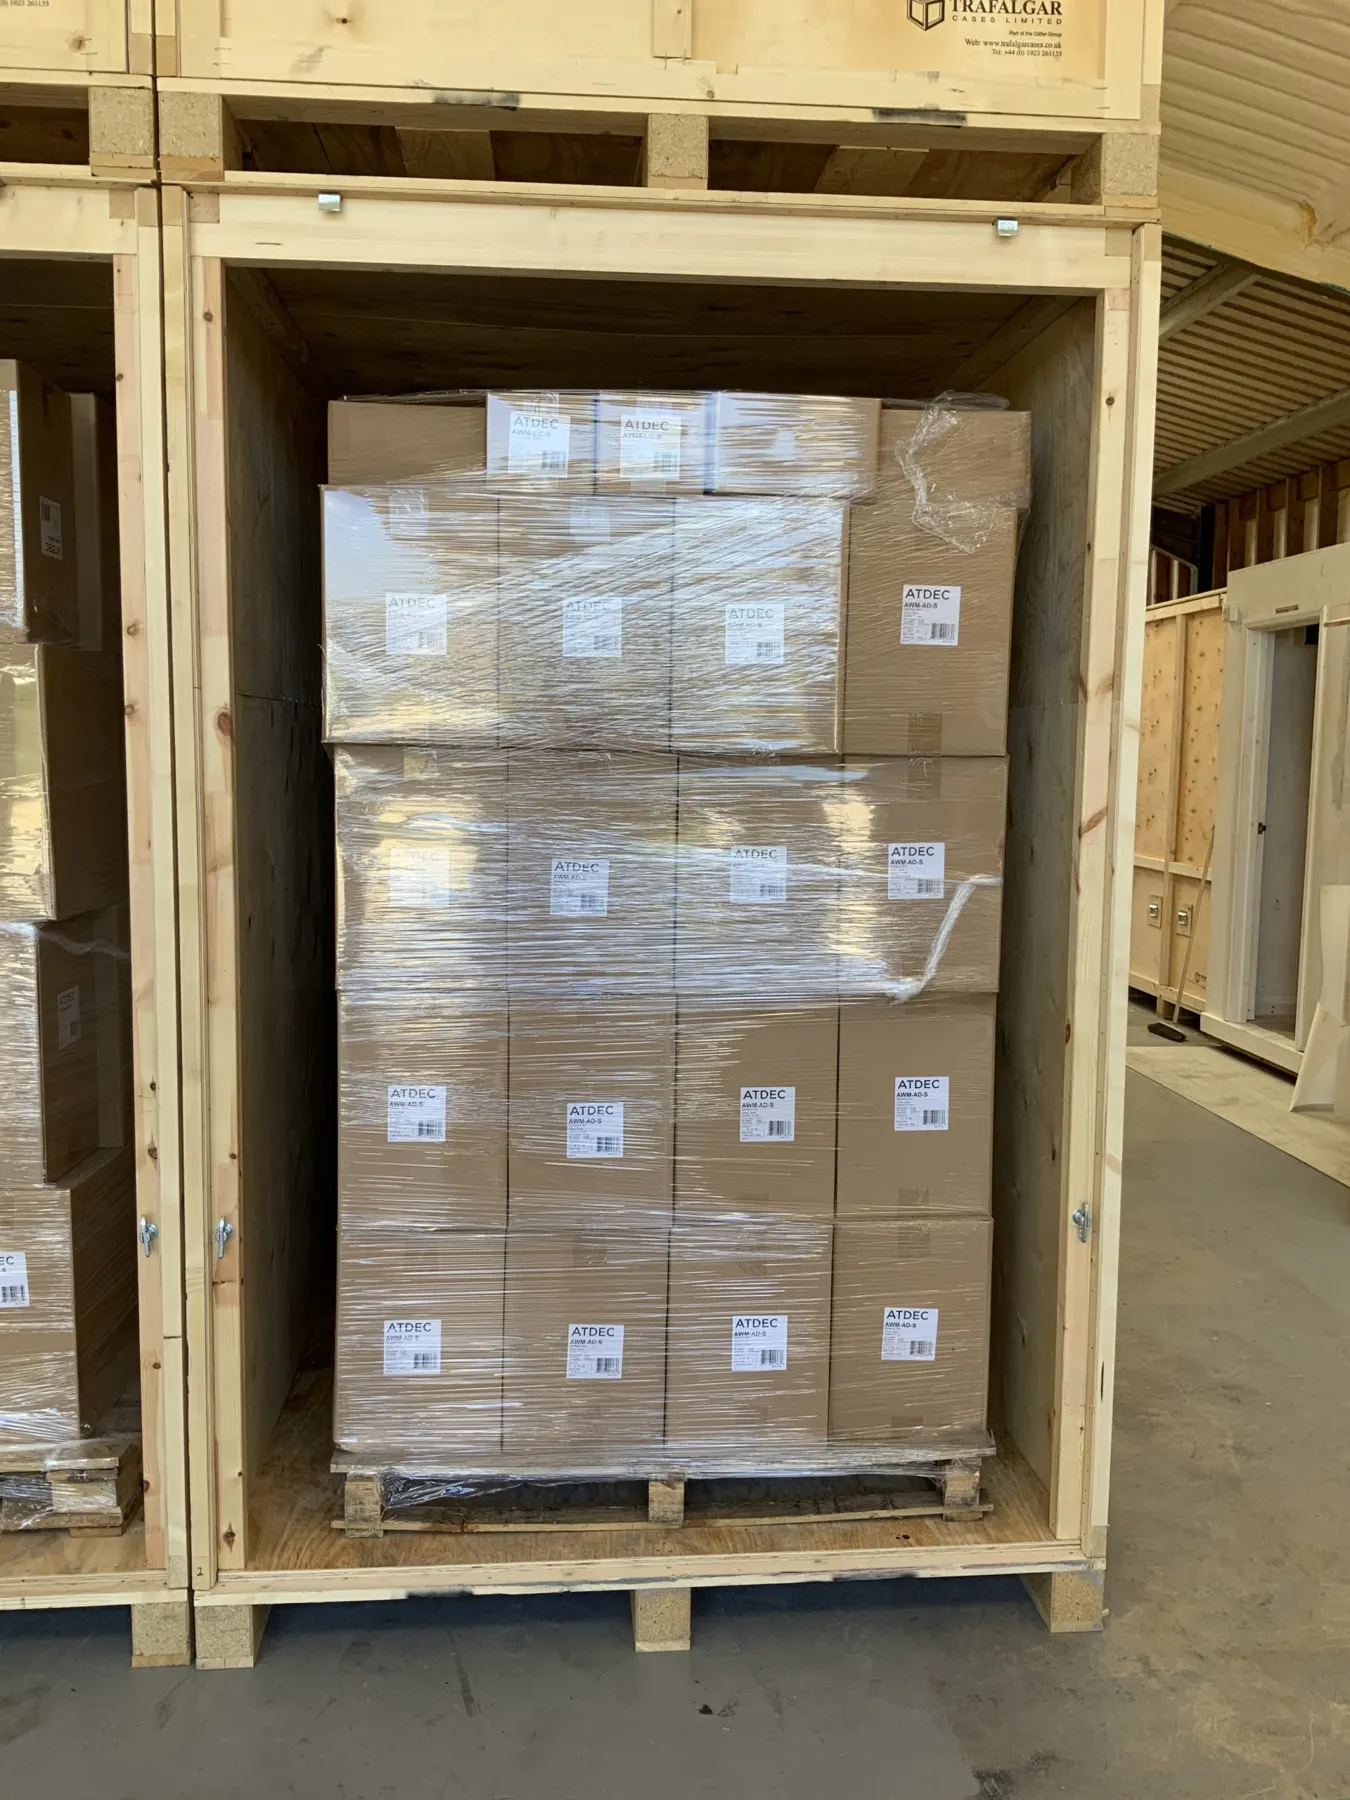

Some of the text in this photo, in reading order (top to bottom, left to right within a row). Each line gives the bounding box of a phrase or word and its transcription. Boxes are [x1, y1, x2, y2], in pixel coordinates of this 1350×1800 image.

[950, 0, 1063, 16] TRAFALGAR
[952, 15, 1062, 25] CASES LIMITED
[965, 38, 981, 46] Web:
[514, 416, 559, 430] ATDEC
[624, 419, 669, 431] ATDEC
[905, 588, 951, 600] ATDEC
[388, 597, 436, 609] ATDEC
[566, 600, 611, 612] ATDEC
[904, 602, 938, 610] AWM-AD-S
[728, 607, 774, 619] ATDEC
[733, 848, 778, 860] ATDEC
[891, 846, 935, 857] ATDEC
[554, 861, 600, 873] ATDEC
[890, 858, 923, 866] AWM-AD-S
[897, 1079, 940, 1090] ATDEC
[390, 1088, 436, 1099] ATDEC
[742, 1089, 786, 1100] ATDEC
[896, 1091, 929, 1099] AWM-AD-S
[569, 1105, 614, 1116] ATDEC
[742, 1101, 774, 1109] AWM-AD-S
[568, 1117, 602, 1125] AWM-AD-S
[886, 1310, 929, 1320] ATDEC
[387, 1322, 432, 1333] ATDEC
[735, 1318, 779, 1328] ATDEC
[884, 1321, 917, 1329] AWM-AD-S
[571, 1326, 615, 1337] ATDEC
